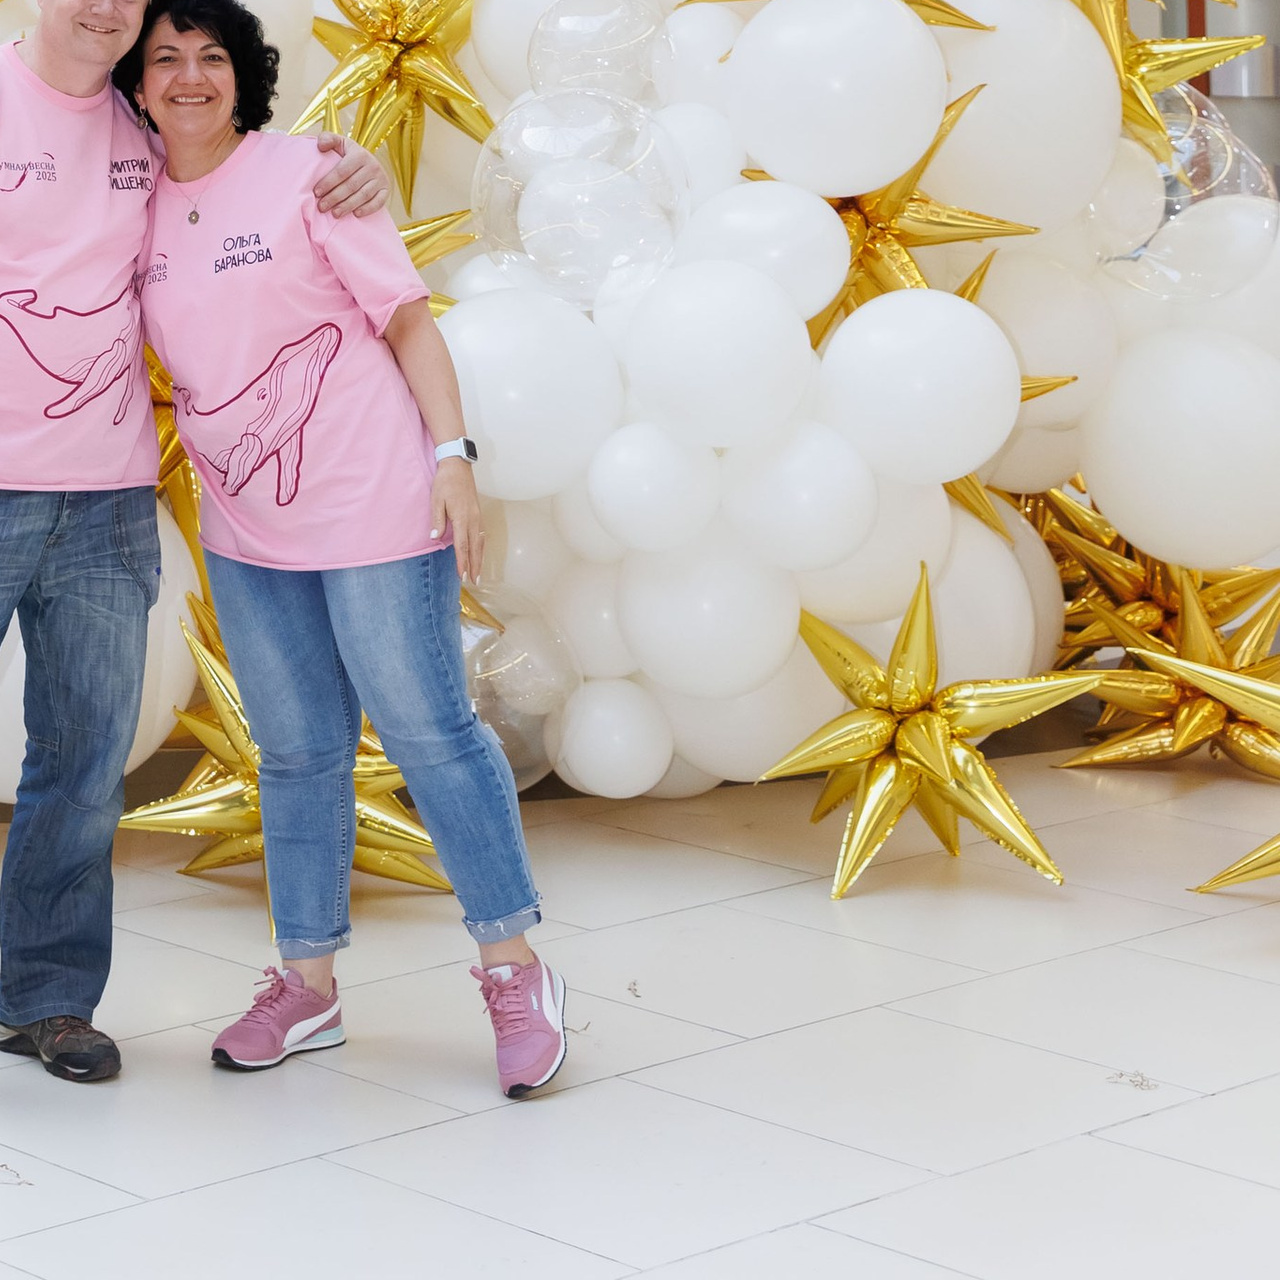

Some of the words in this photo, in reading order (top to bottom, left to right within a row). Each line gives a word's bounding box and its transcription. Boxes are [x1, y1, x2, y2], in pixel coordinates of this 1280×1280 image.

[30, 161, 56, 171] ВЕСНА
[35, 170, 57, 182] 2025
[108, 175, 153, 192] ИЩЕНКО
[223, 233, 261, 252] ОЛЬГА
[214, 248, 273, 273] БАРАНОВА
